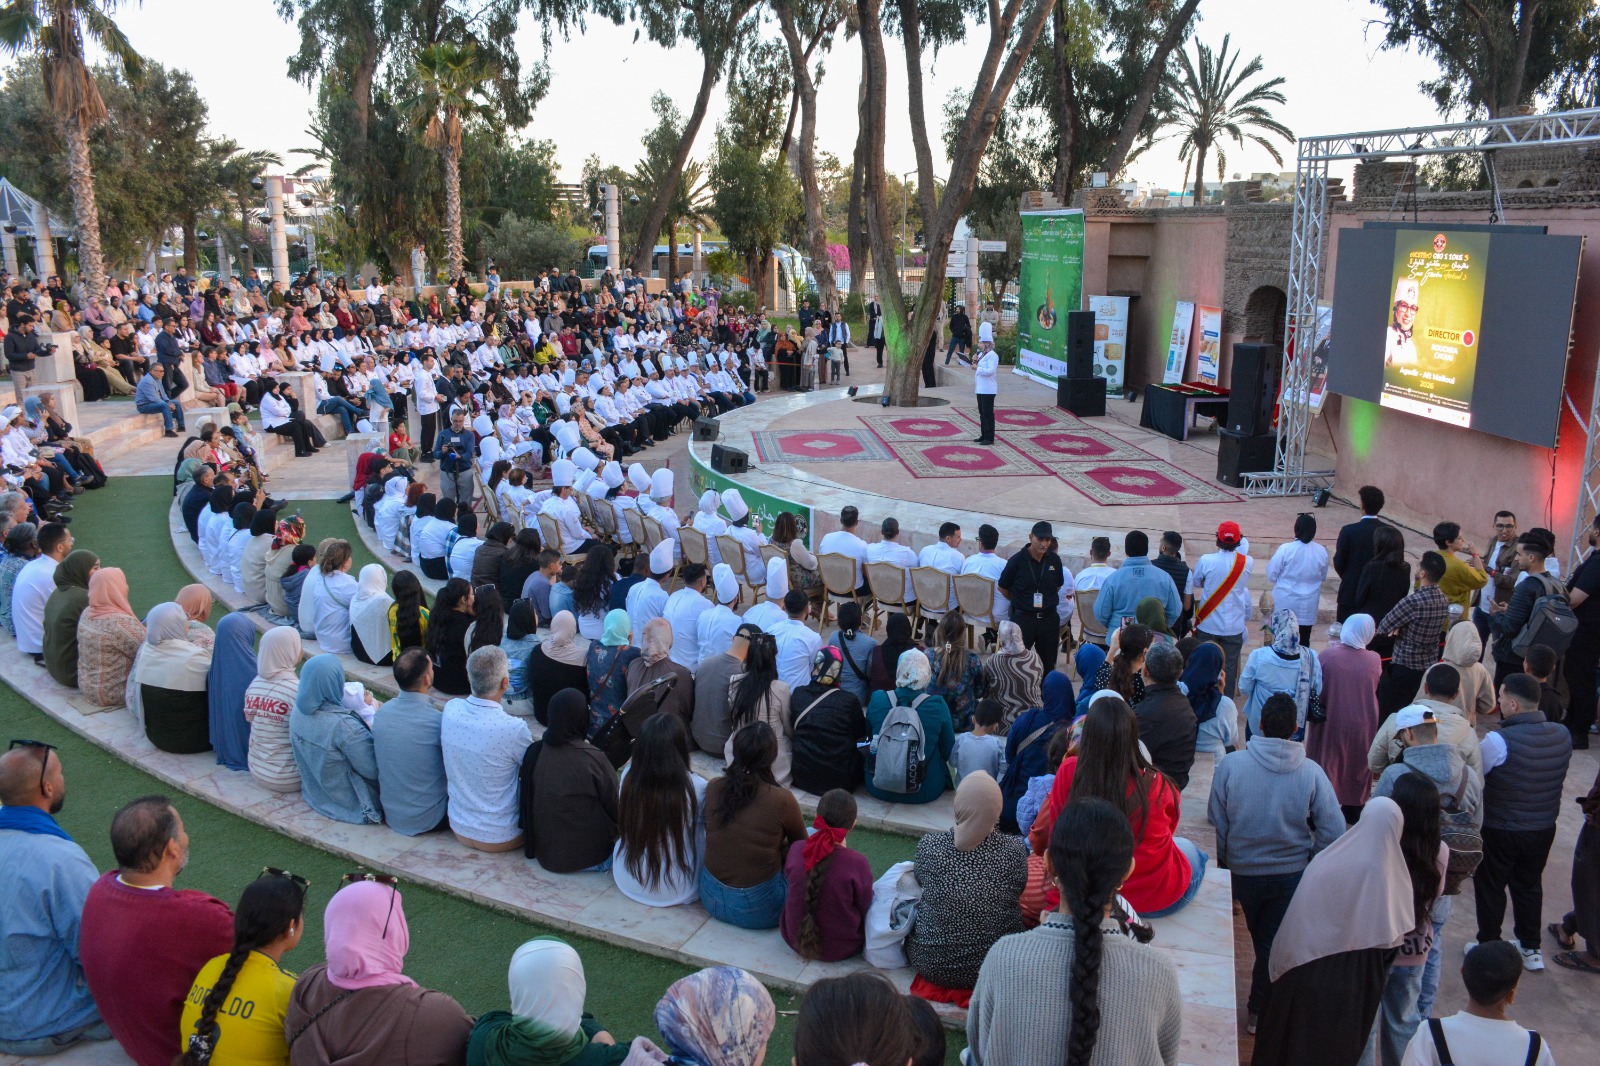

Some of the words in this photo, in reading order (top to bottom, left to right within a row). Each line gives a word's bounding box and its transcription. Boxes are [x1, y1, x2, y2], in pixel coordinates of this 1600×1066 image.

[1428, 328, 1460, 341] DIRECTOR
[1419, 380, 1435, 390] 2026
[245, 695, 289, 715] HANKS
[909, 745, 918, 790] LACOSTE
[187, 985, 255, 1019] ROLDO
